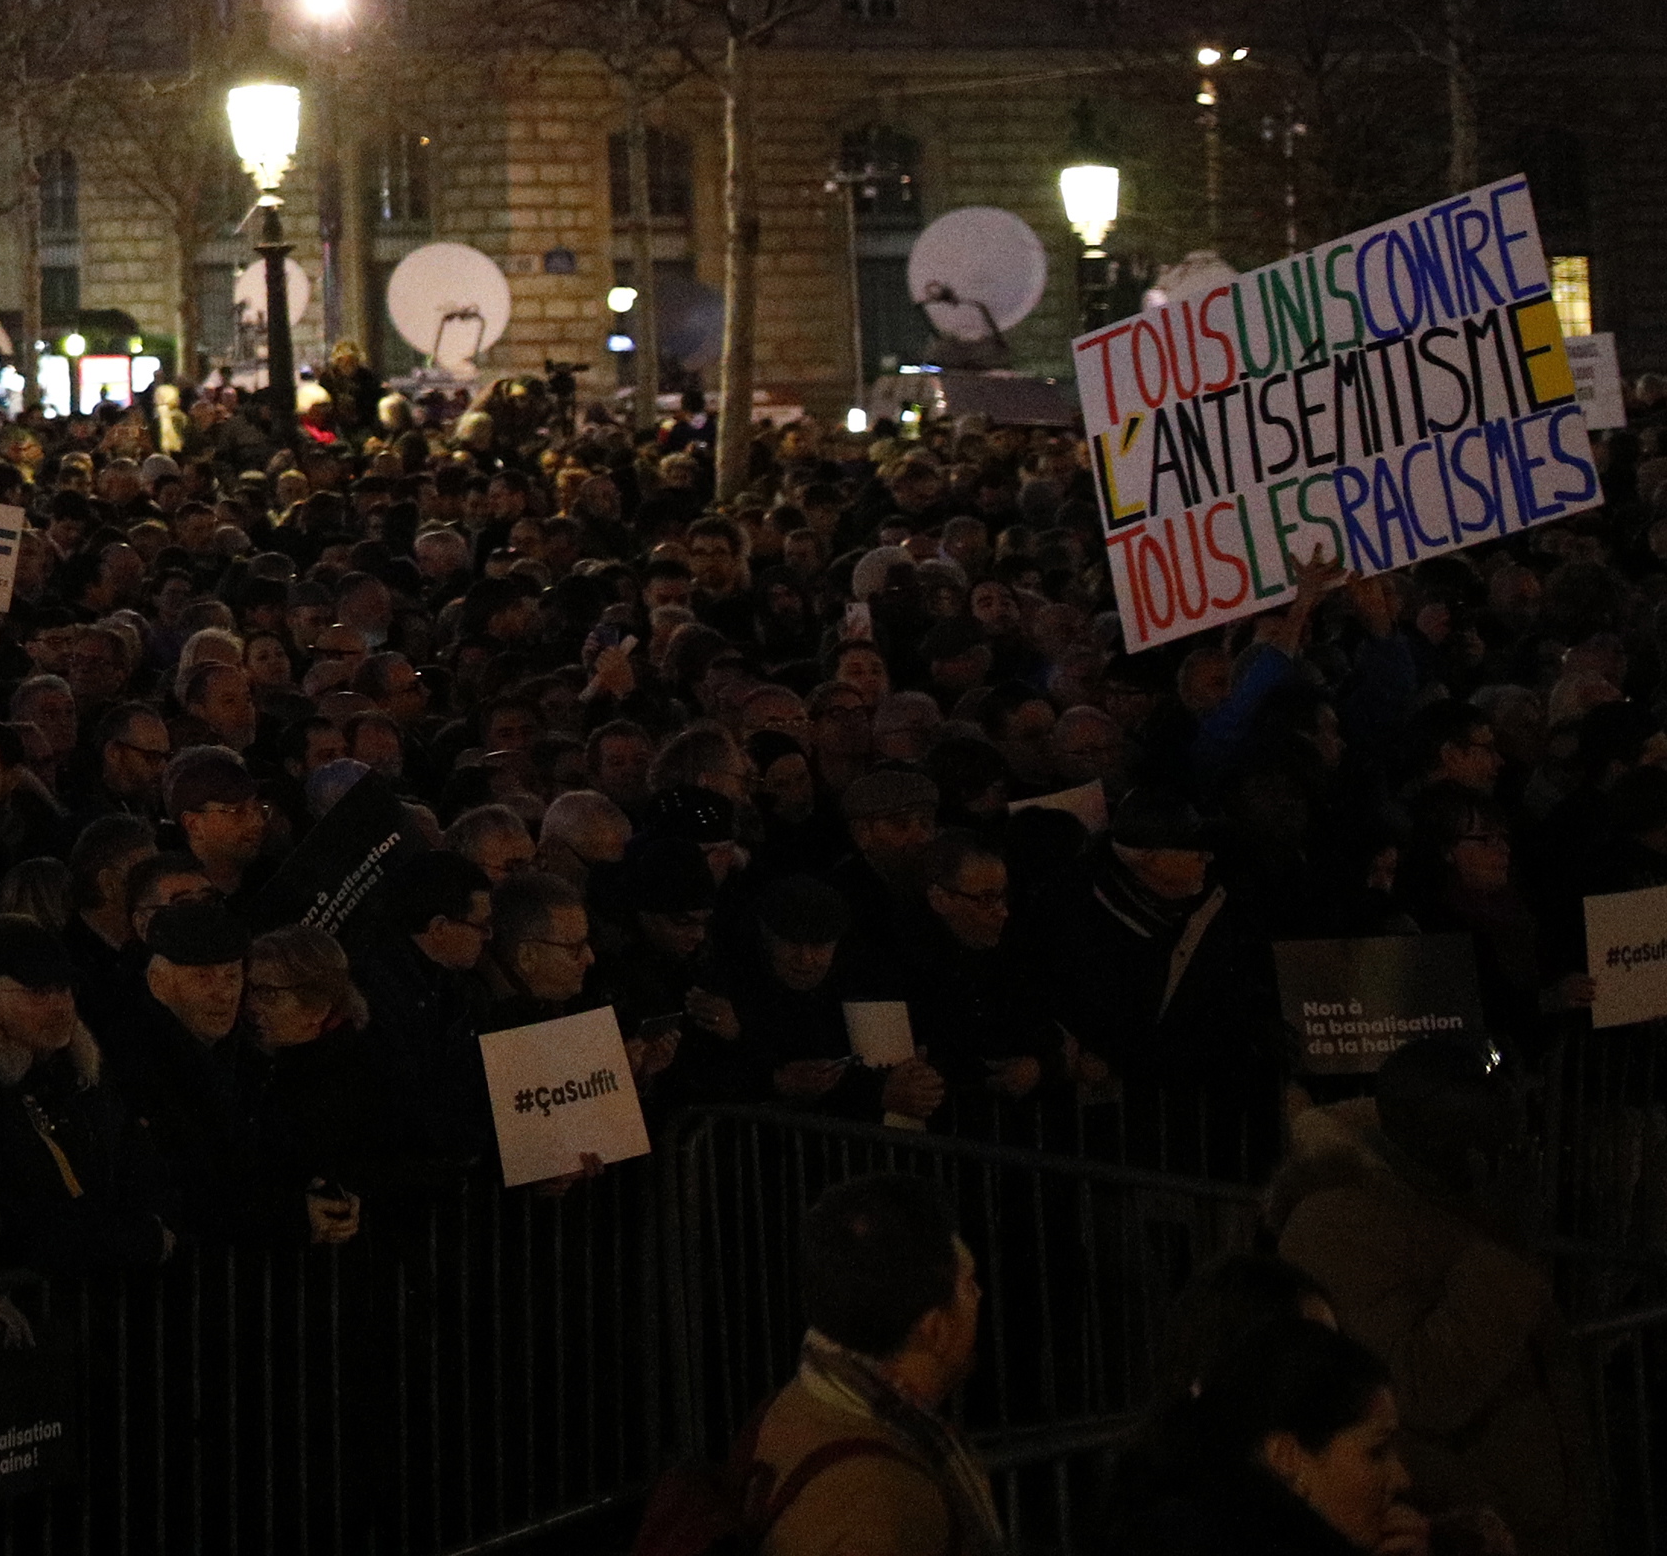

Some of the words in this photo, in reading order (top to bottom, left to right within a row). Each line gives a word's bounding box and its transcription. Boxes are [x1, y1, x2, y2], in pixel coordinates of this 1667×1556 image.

[1077, 285, 1237, 425] TOUS
[1230, 244, 1367, 380] UNIS
[1355, 181, 1549, 340] CONTRE
[1092, 292, 1575, 530] L'ANTISÉMITISME
[1105, 500, 1249, 642] TOUS
[1235, 473, 1345, 601] LES
[1334, 405, 1597, 572] RACISMES
[1303, 1001, 1344, 1017] Non
[1348, 998, 1363, 1015] à
[1306, 1020, 1327, 1036] la
[1329, 1012, 1464, 1036] banalisation
[1338, 1036, 1360, 1054] la
[514, 1067, 619, 1117] #ÇaSuffit
